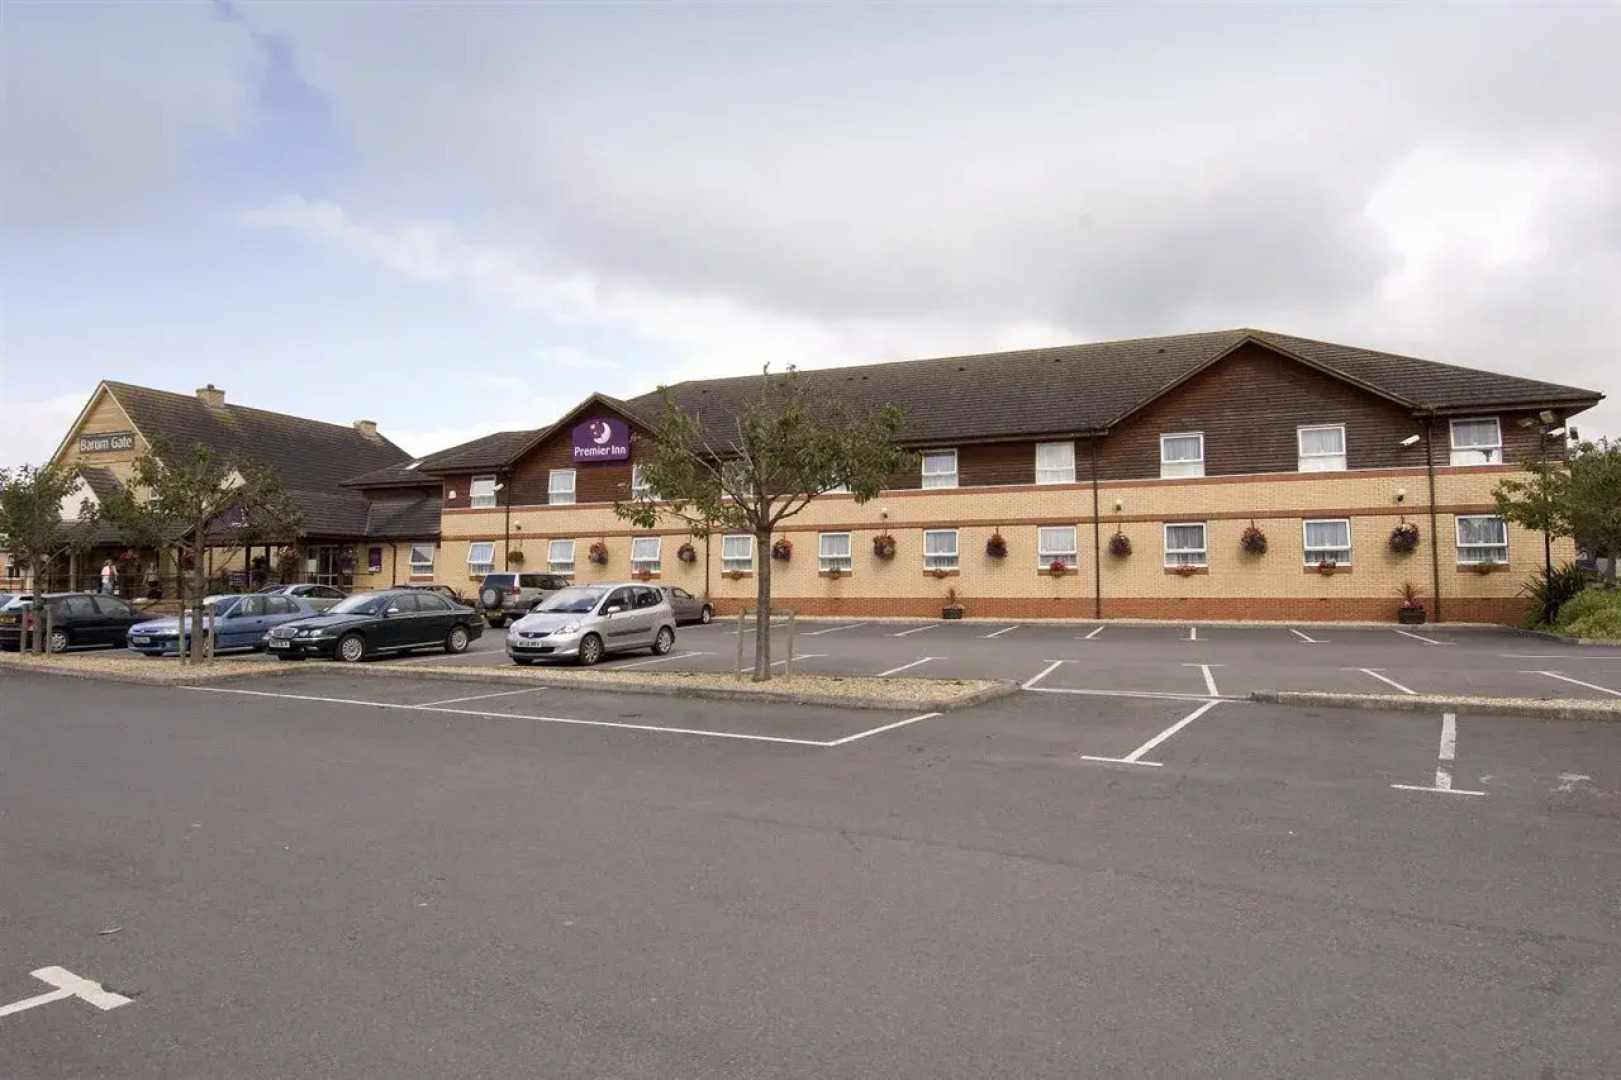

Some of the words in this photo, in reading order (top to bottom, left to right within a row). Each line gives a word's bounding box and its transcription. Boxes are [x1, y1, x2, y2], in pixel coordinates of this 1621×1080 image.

[111, 436, 132, 448] Gate
[574, 445, 610, 457] Premier
[611, 444, 627, 455] Inn
